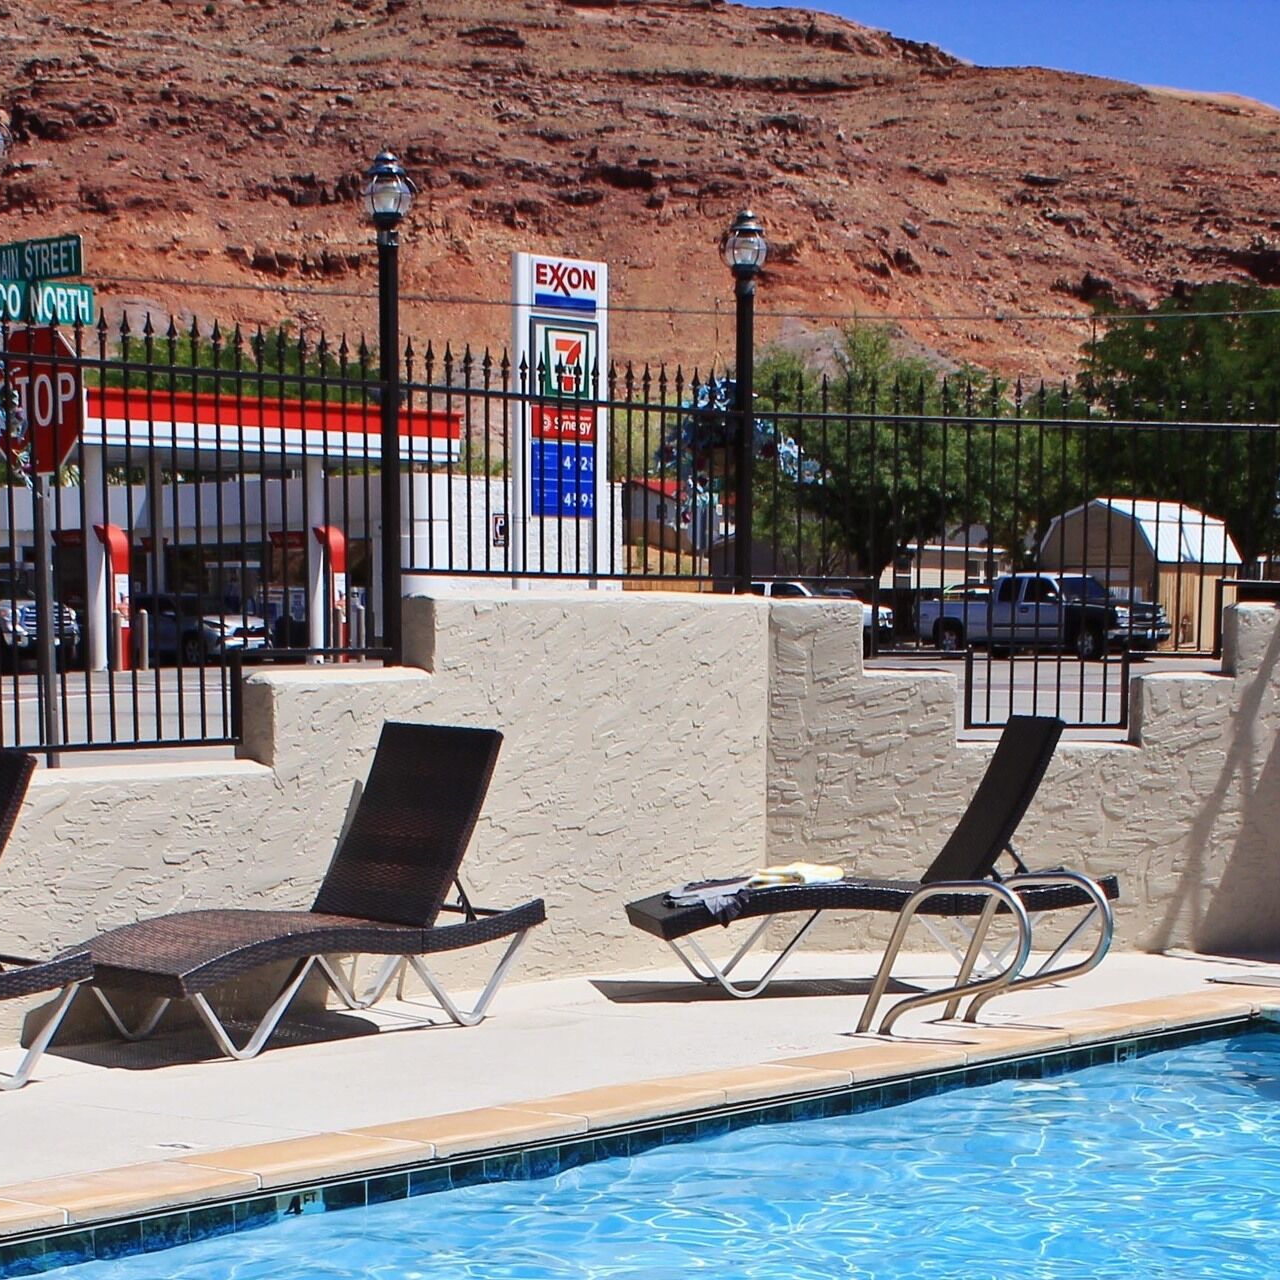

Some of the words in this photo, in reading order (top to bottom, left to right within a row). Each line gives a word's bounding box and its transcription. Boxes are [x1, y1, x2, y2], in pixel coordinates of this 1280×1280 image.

[24, 240, 77, 279] STREET
[536, 262, 596, 297] EXXON
[30, 281, 90, 322] NORTH
[555, 338, 581, 391] 7
[14, 372, 76, 427] TOP
[554, 416, 592, 435] Synegy
[283, 1194, 304, 1216] 4
[304, 1191, 317, 1205] FT
